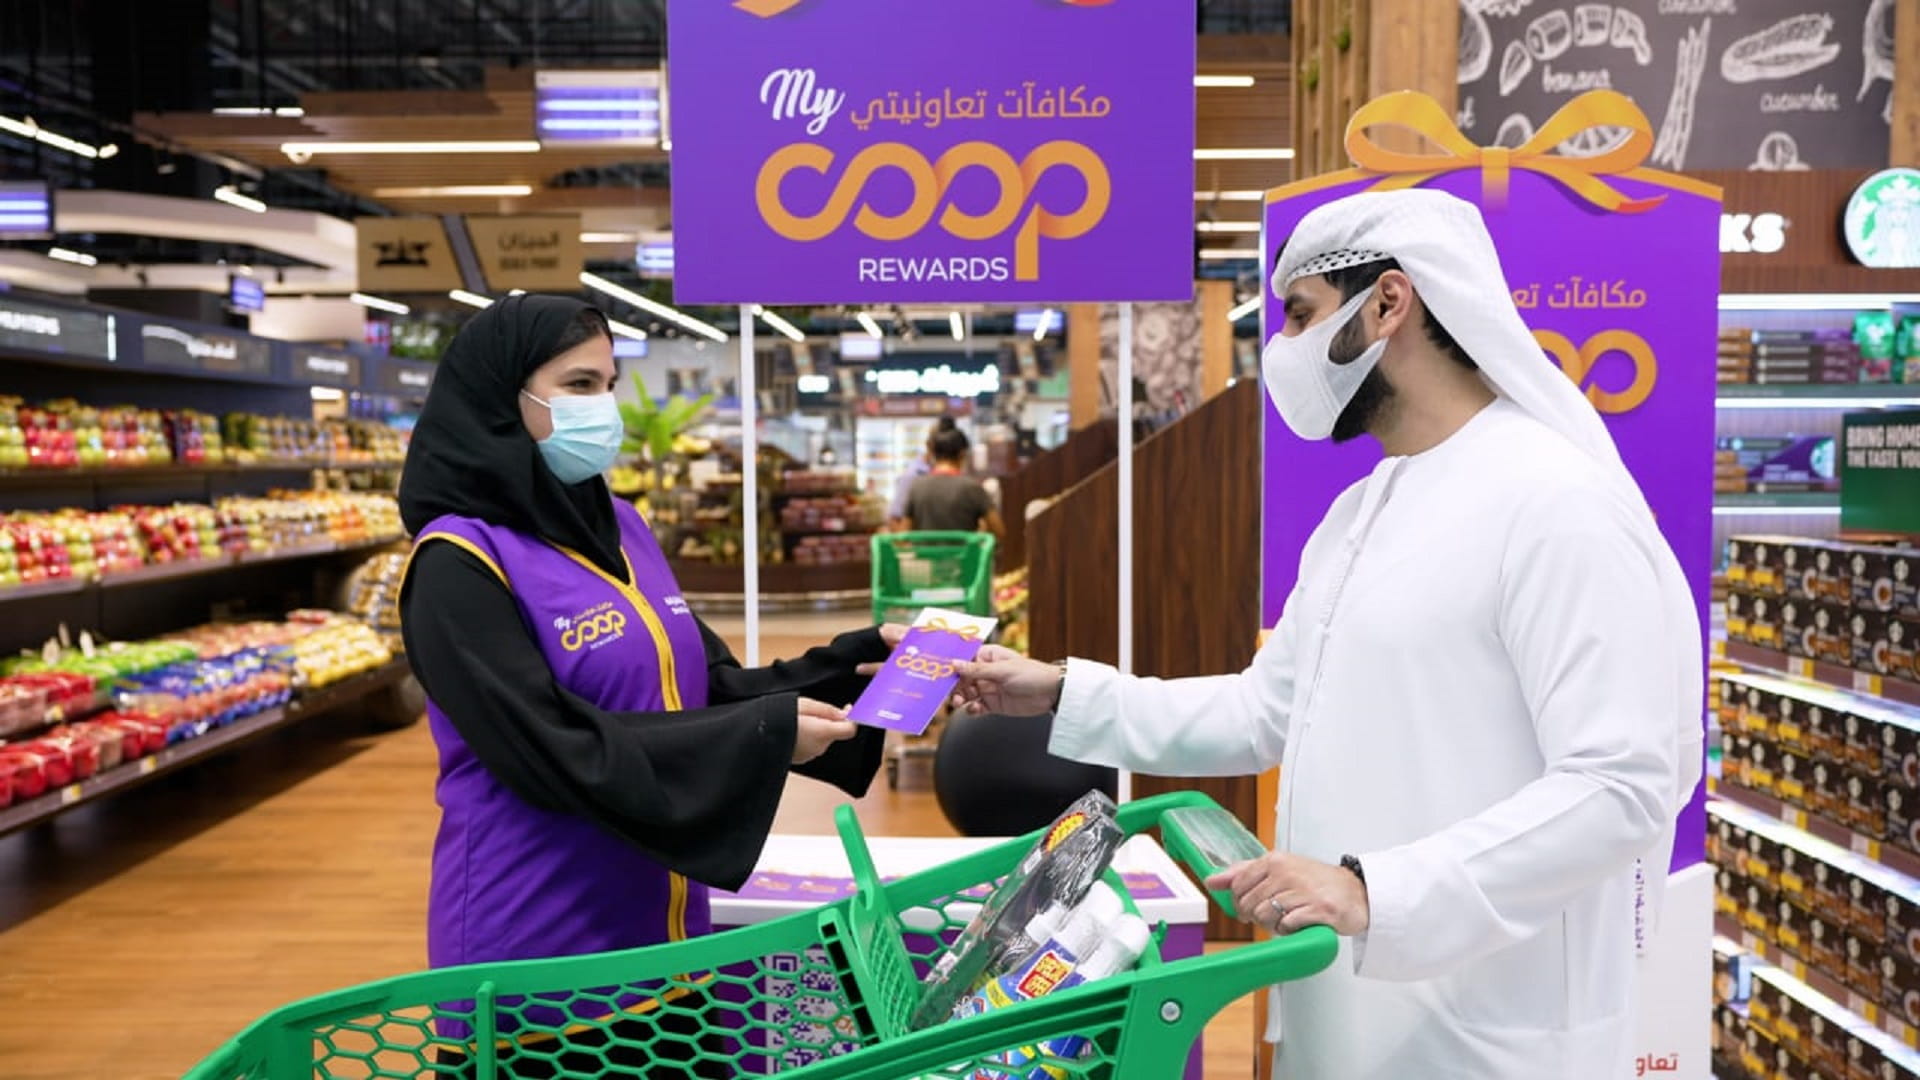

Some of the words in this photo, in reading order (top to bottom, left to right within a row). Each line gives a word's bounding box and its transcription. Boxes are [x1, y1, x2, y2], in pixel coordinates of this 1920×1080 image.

[1543, 64, 1613, 94] banana
[760, 68, 846, 135] My
[850, 87, 988, 131] تعاونيتي
[997, 82, 1112, 118] مكافآت
[1760, 84, 1840, 112] cucumber
[858, 257, 1009, 282] REWARDS
[1547, 276, 1648, 309] مكافآت
[1847, 426, 1884, 448] BRING
[1847, 450, 1866, 468] THE
